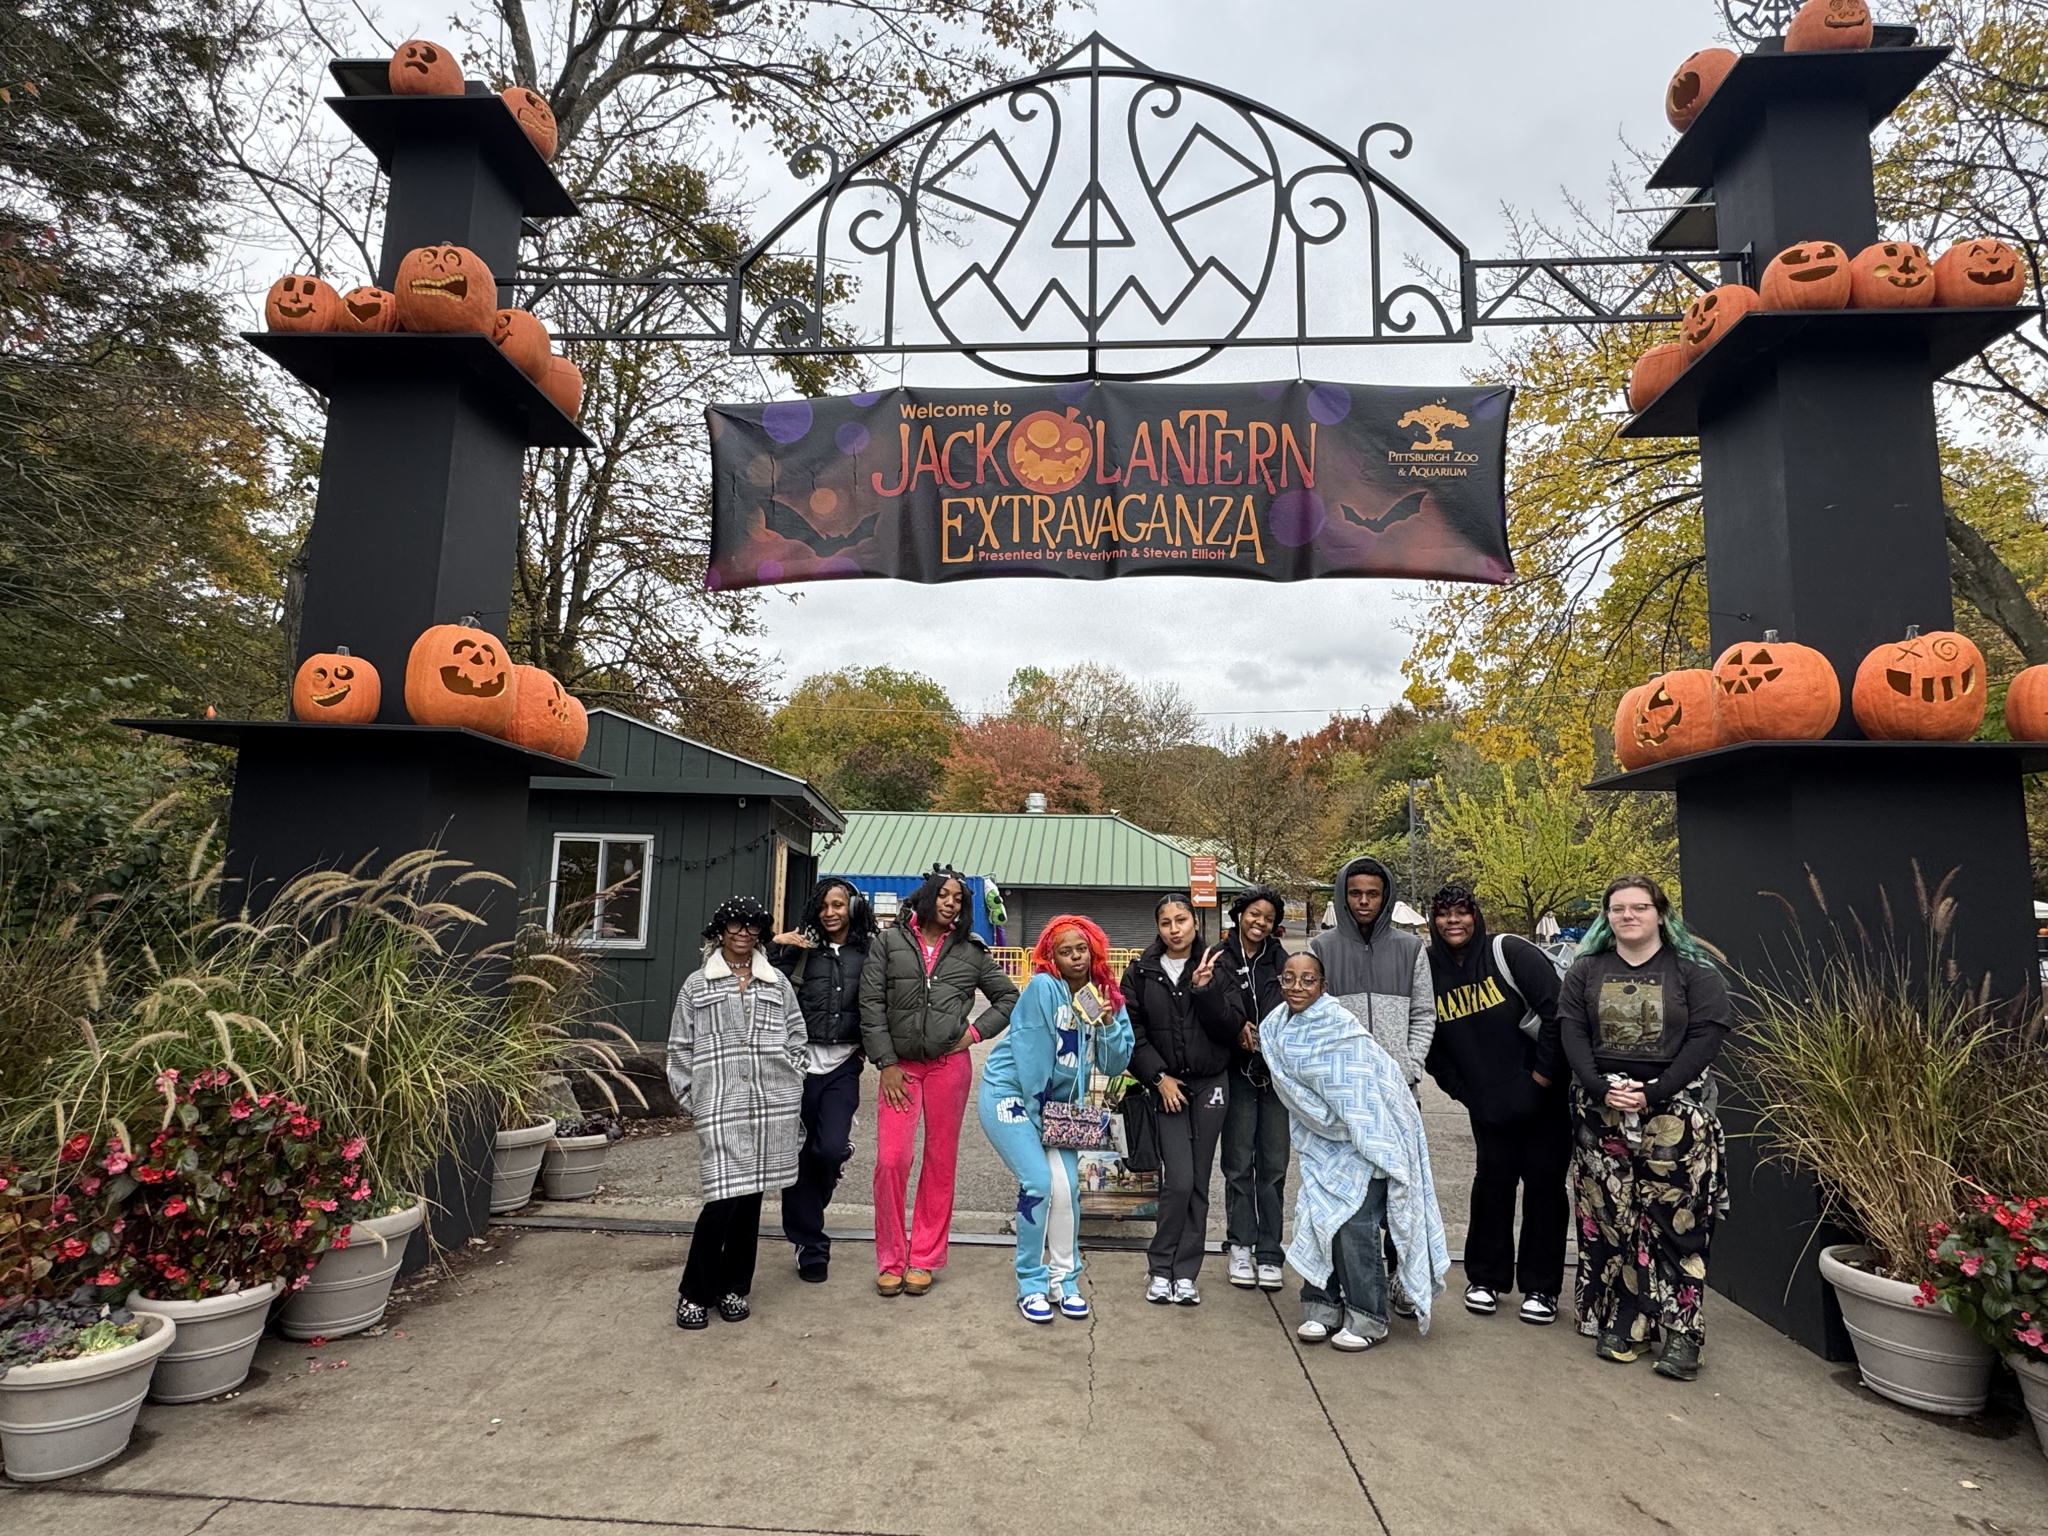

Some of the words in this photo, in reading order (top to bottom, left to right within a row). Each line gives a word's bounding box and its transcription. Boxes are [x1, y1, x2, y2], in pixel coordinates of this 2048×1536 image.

[900, 402, 988, 420] Welcome
[992, 401, 1012, 416] to
[871, 420, 1012, 498] JACK
[1388, 451, 1450, 462] PITTSBURGH
[1454, 451, 1479, 462] ZOO
[1397, 467, 1407, 477] &
[1408, 465, 1468, 478] AQUARIUM
[941, 493, 1266, 564] EXTRAVAGANZA
[978, 549, 1043, 562] Presented
[1046, 549, 1063, 562] by
[1066, 548, 1127, 562] Beverlynn
[1131, 548, 1140, 558] &
[1143, 547, 1188, 559] Steven
[1191, 548, 1226, 560] Elliott
[1209, 1086, 1225, 1105] A
